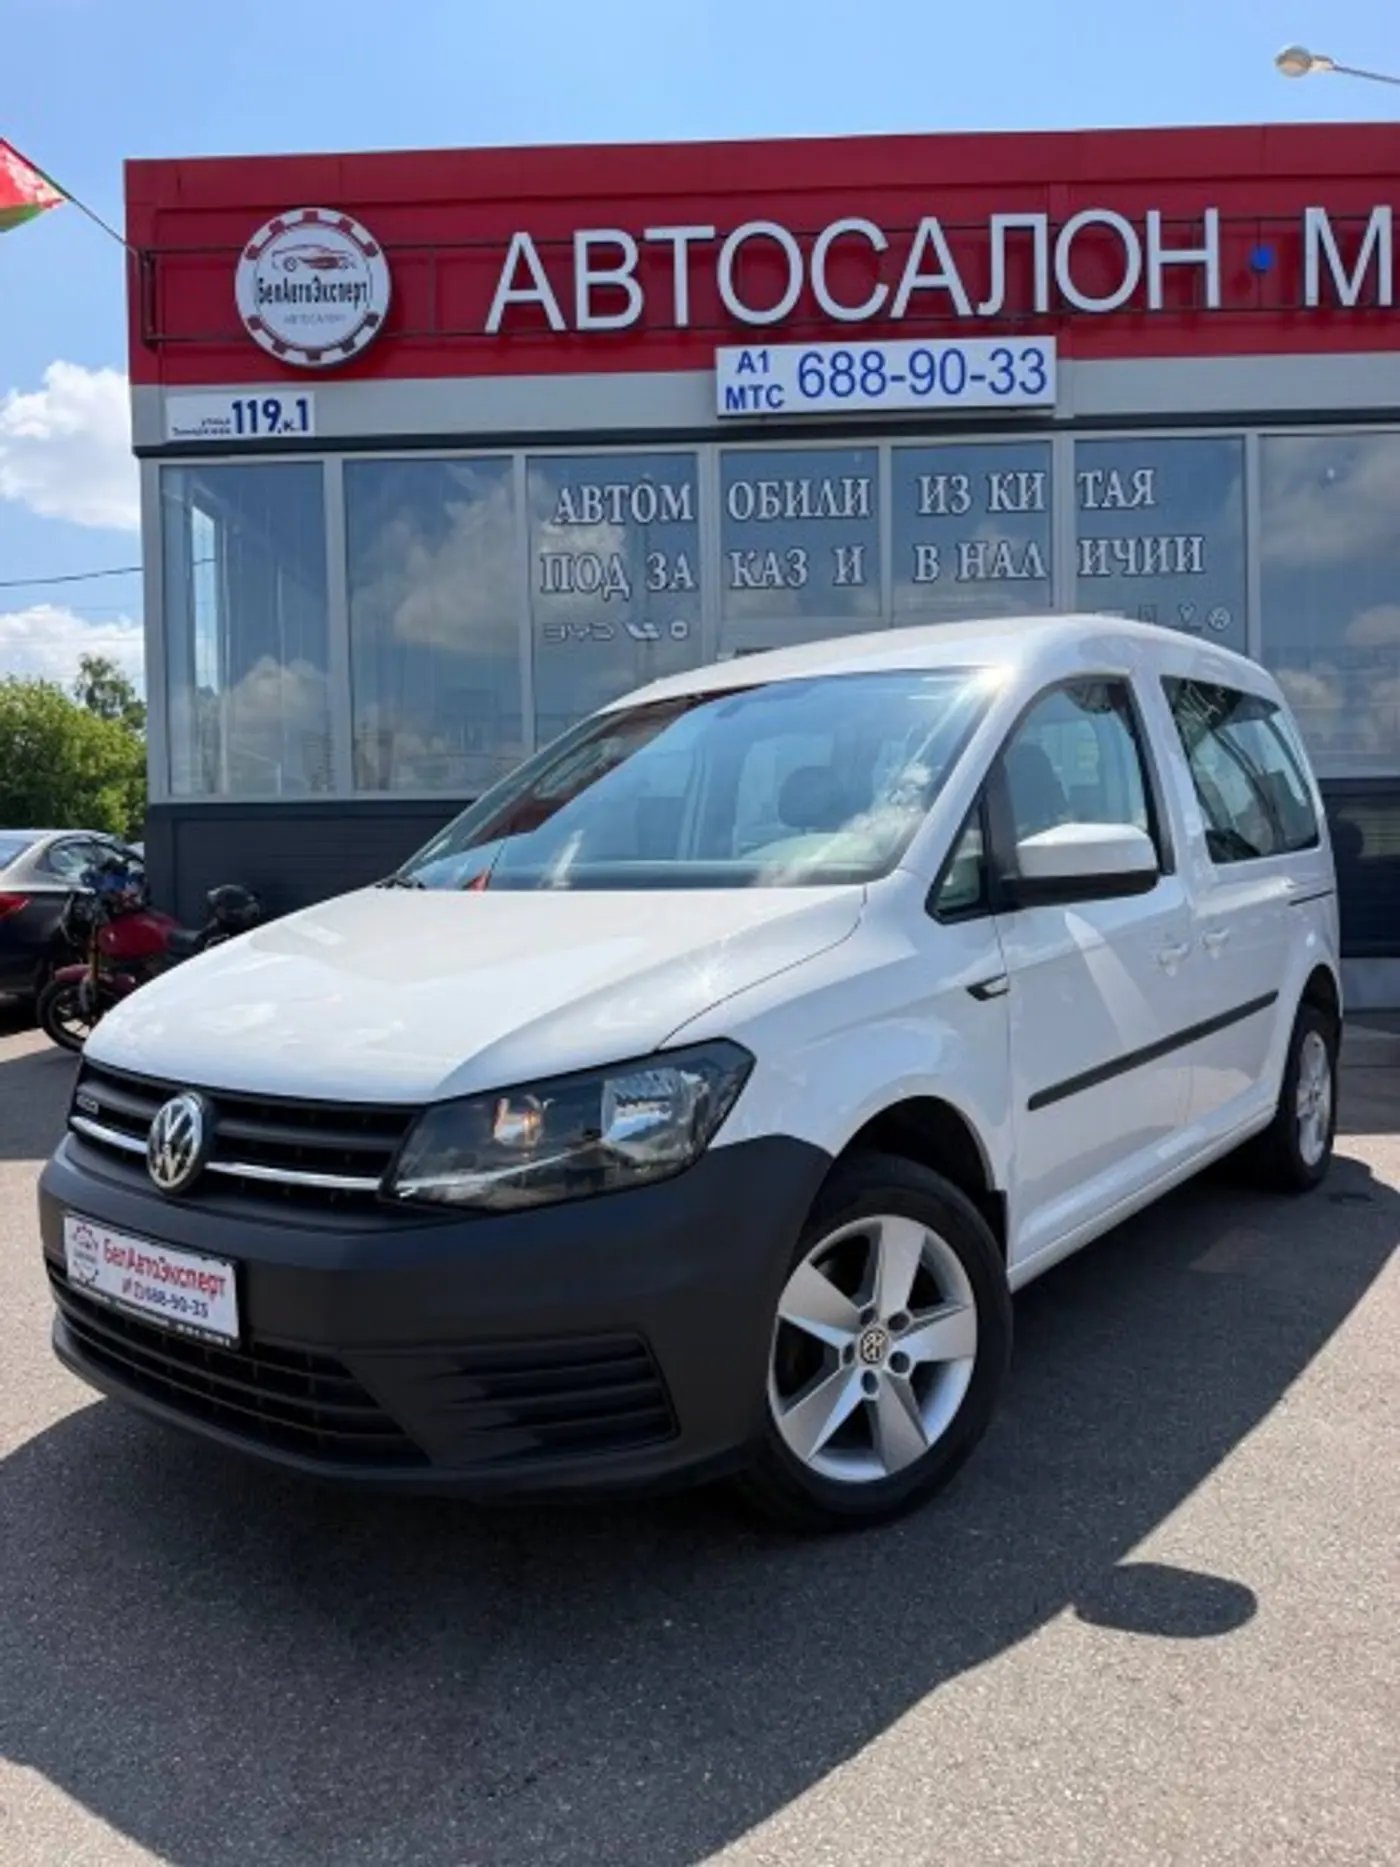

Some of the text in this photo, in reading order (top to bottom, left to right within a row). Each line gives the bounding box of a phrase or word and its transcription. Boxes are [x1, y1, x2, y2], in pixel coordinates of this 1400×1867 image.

[485, 205, 1393, 333] АВТОСАЛОН М
[725, 384, 784, 410] МТС
[797, 347, 1047, 399] 688-90-33
[917, 474, 971, 515] ИЗ
[541, 552, 630, 600] ПОД
[833, 545, 866, 586] И
[914, 544, 940, 583] В
